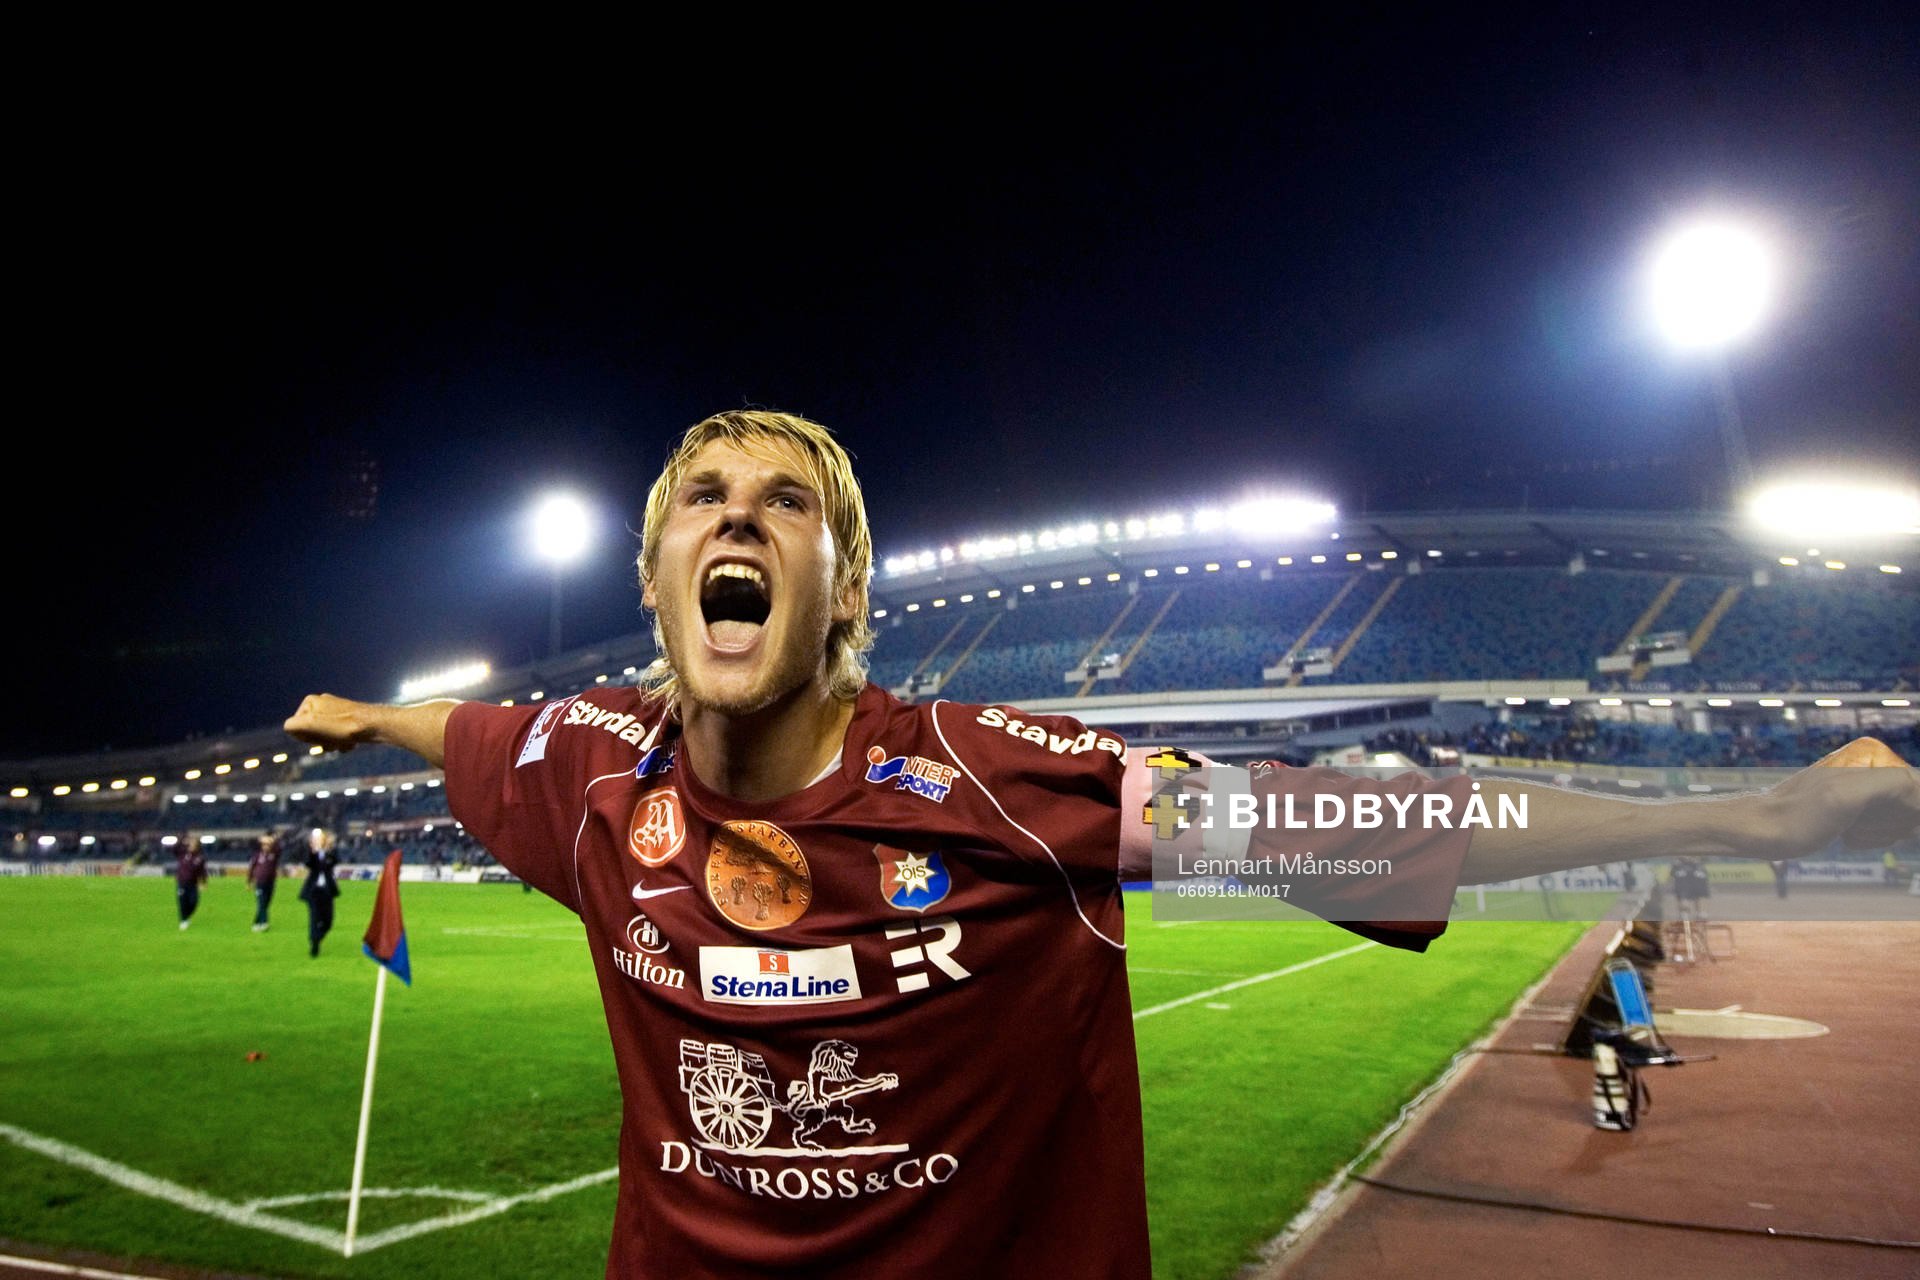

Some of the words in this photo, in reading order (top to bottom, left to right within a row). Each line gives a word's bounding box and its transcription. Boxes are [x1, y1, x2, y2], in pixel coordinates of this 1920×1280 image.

[901, 864, 927, 881] ÖIS
[612, 946, 685, 990] Hilton
[711, 974, 788, 998] Stena
[791, 975, 850, 998] Line
[660, 1140, 858, 1200] DUNROSS
